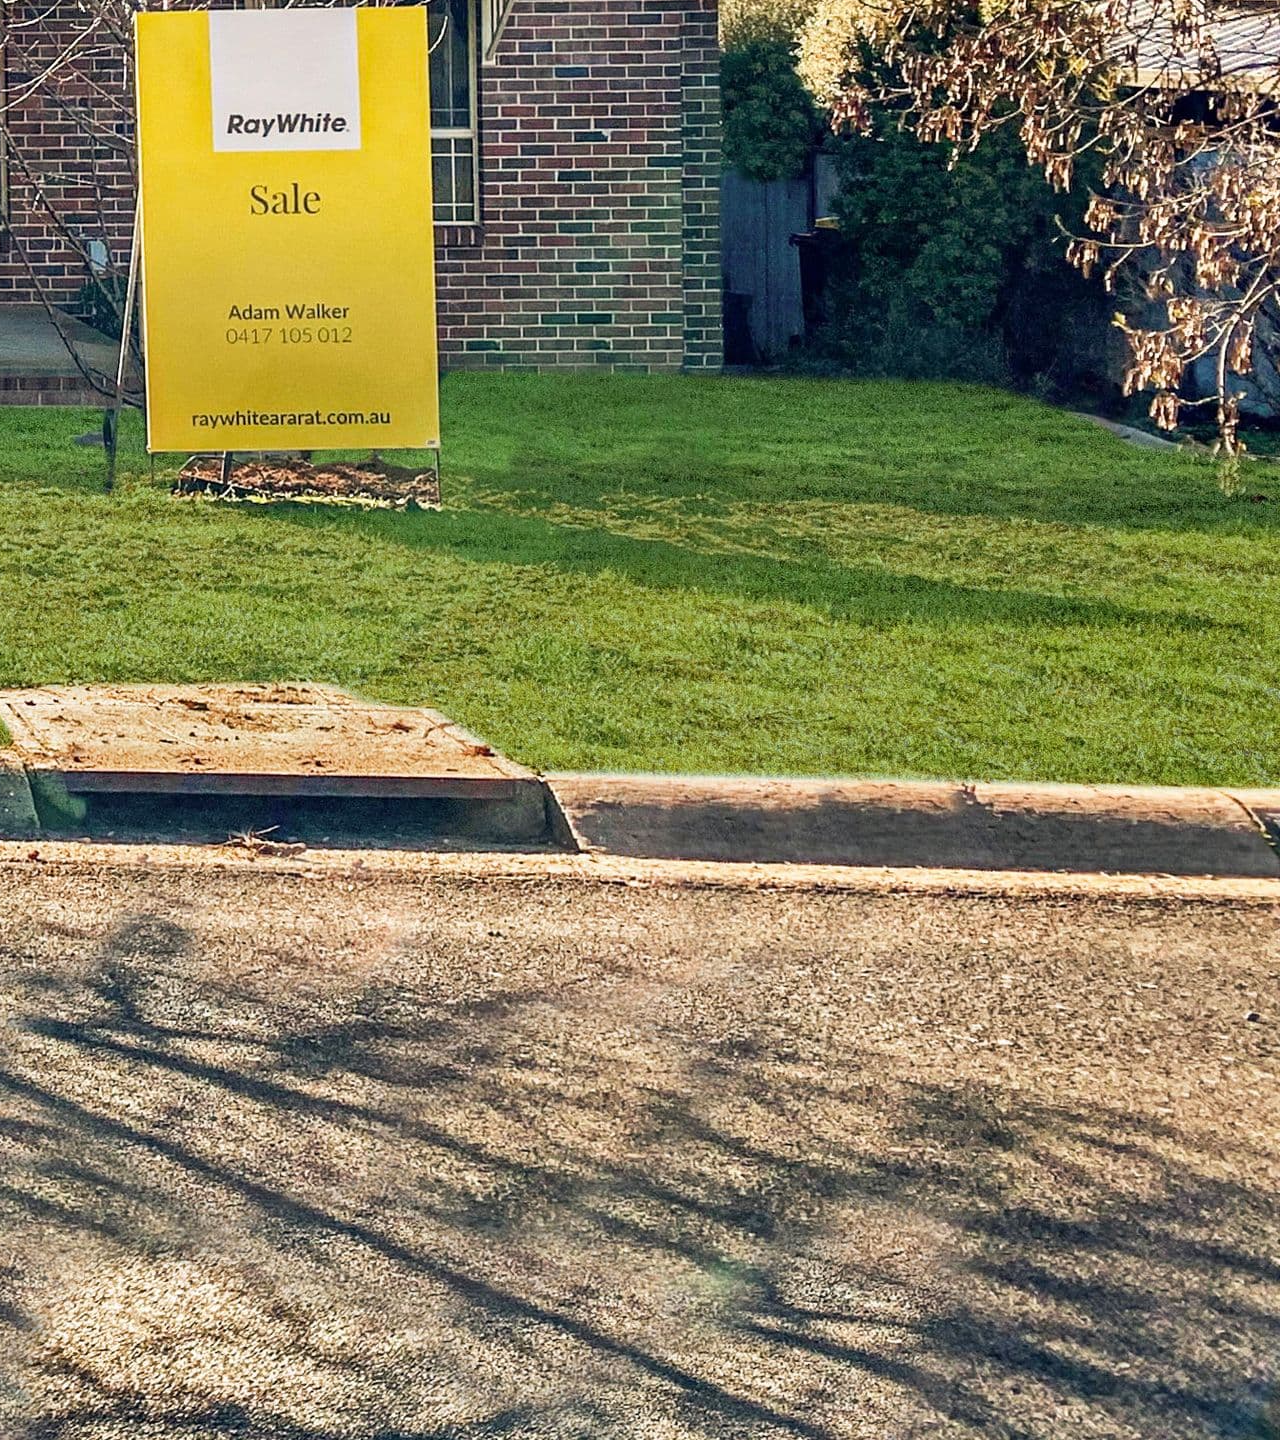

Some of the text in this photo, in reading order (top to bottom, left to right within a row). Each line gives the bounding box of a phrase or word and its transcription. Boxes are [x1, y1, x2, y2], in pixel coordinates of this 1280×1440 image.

[250, 182, 321, 216] Sale
[228, 303, 350, 321] Adam Walker
[226, 326, 353, 345] 0417 105 012
[191, 410, 392, 430] raywhiteararat.com.au
